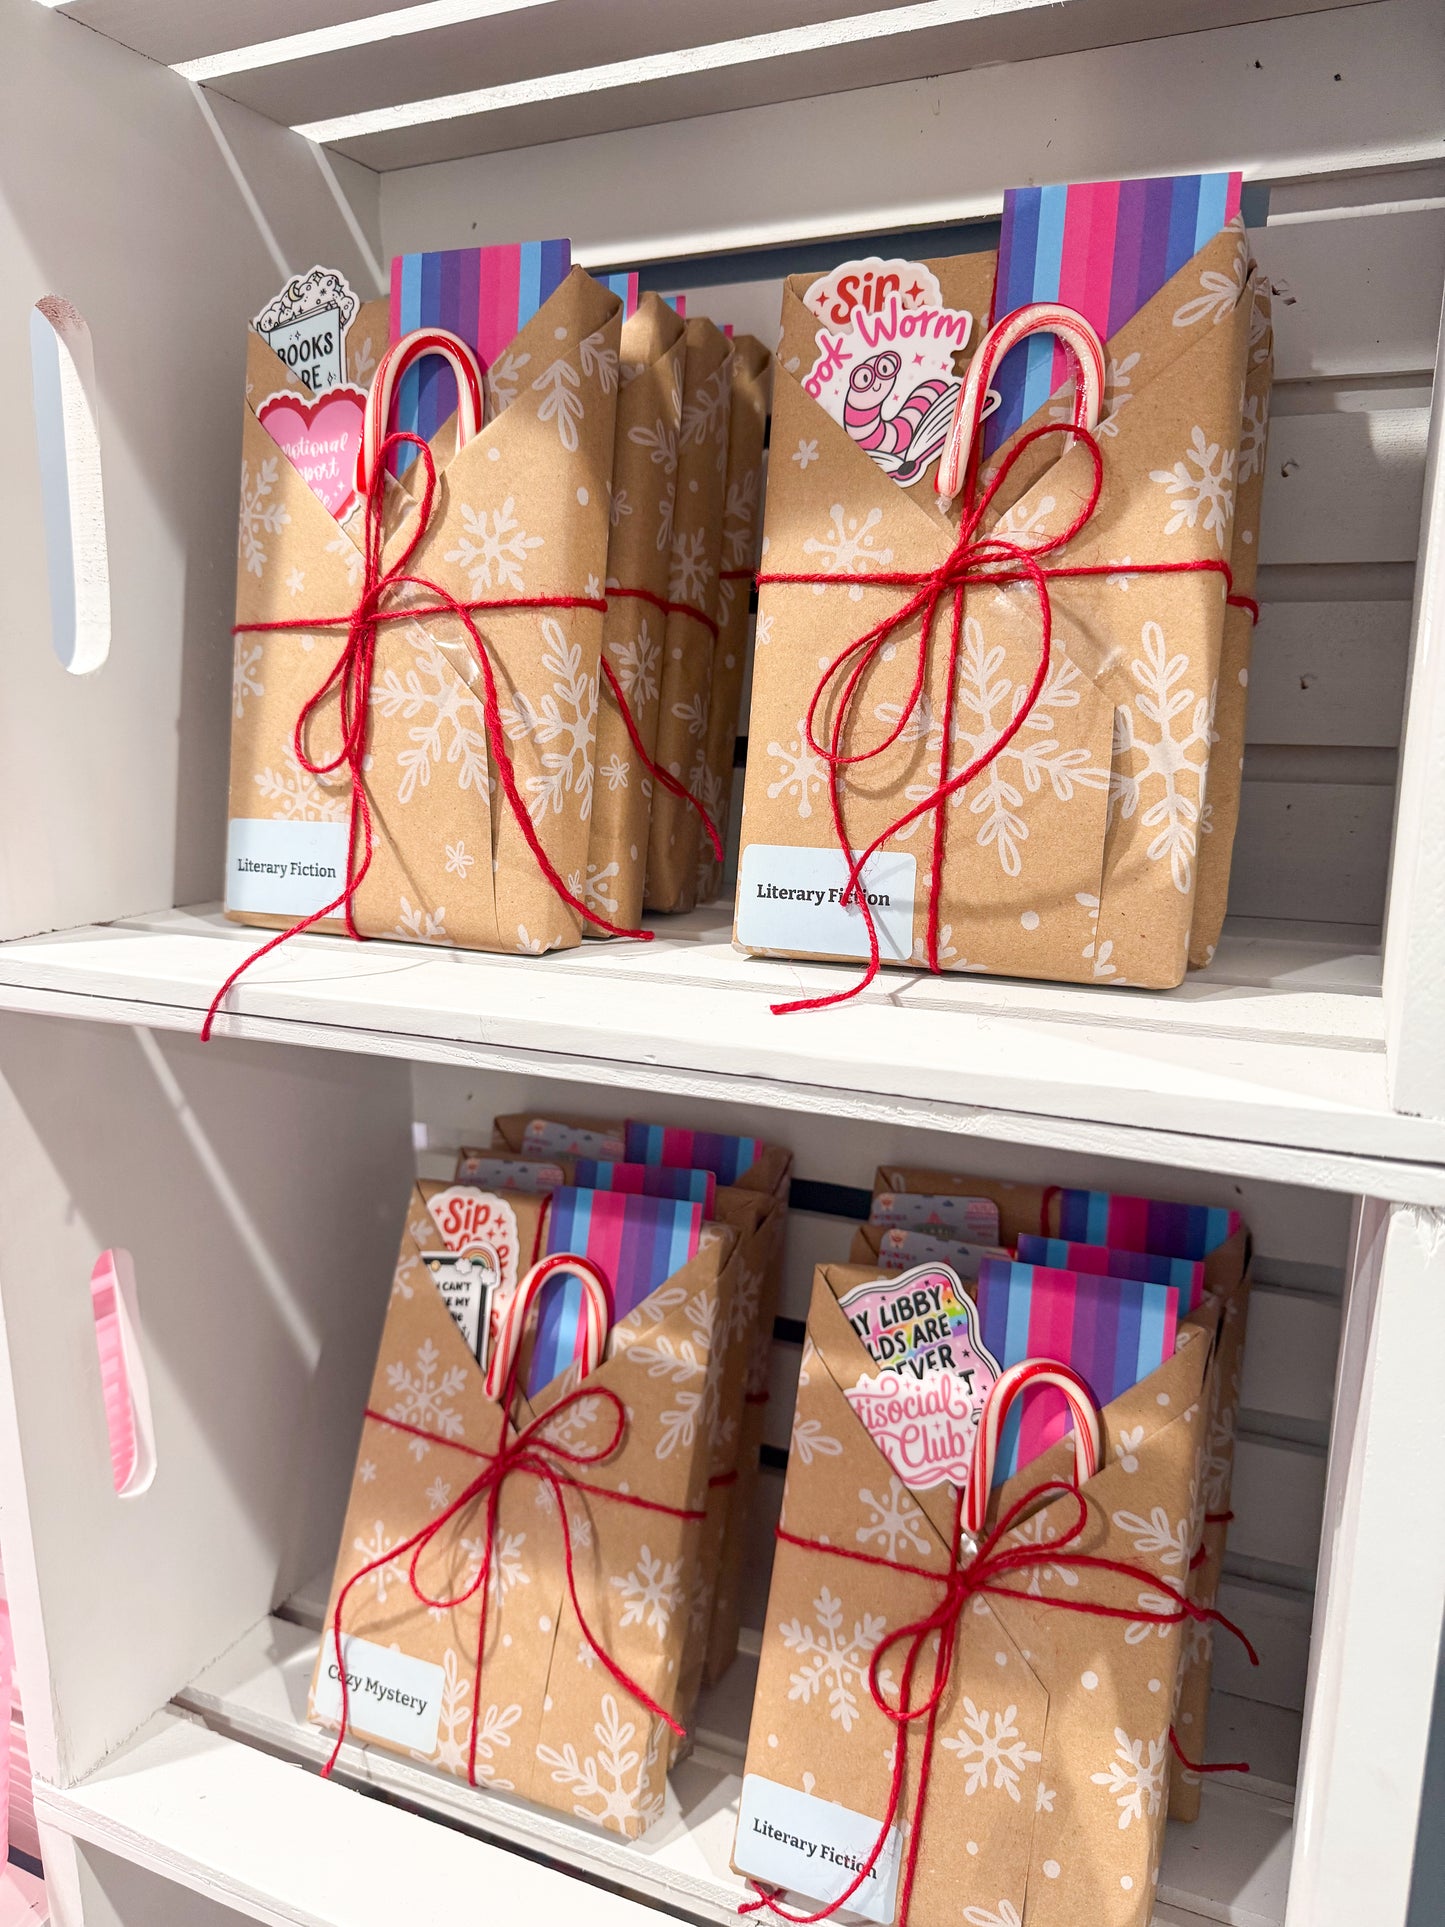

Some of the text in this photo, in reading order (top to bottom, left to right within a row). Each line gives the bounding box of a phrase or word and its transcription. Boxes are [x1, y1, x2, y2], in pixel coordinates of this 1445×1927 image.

[804, 296, 967, 400] ook Worm
[301, 364, 323, 391] RE
[237, 858, 337, 879] Literary Fiction
[756, 884, 826, 907] Literary
[443, 1197, 491, 1235] Sip
[880, 1285, 942, 1329] LIBBY
[866, 1313, 952, 1362] LDS ARE
[854, 1374, 968, 1430] tisocial
[898, 1419, 966, 1468] Club
[364, 1676, 428, 1716] Mystery
[752, 1817, 818, 1858] Literary
